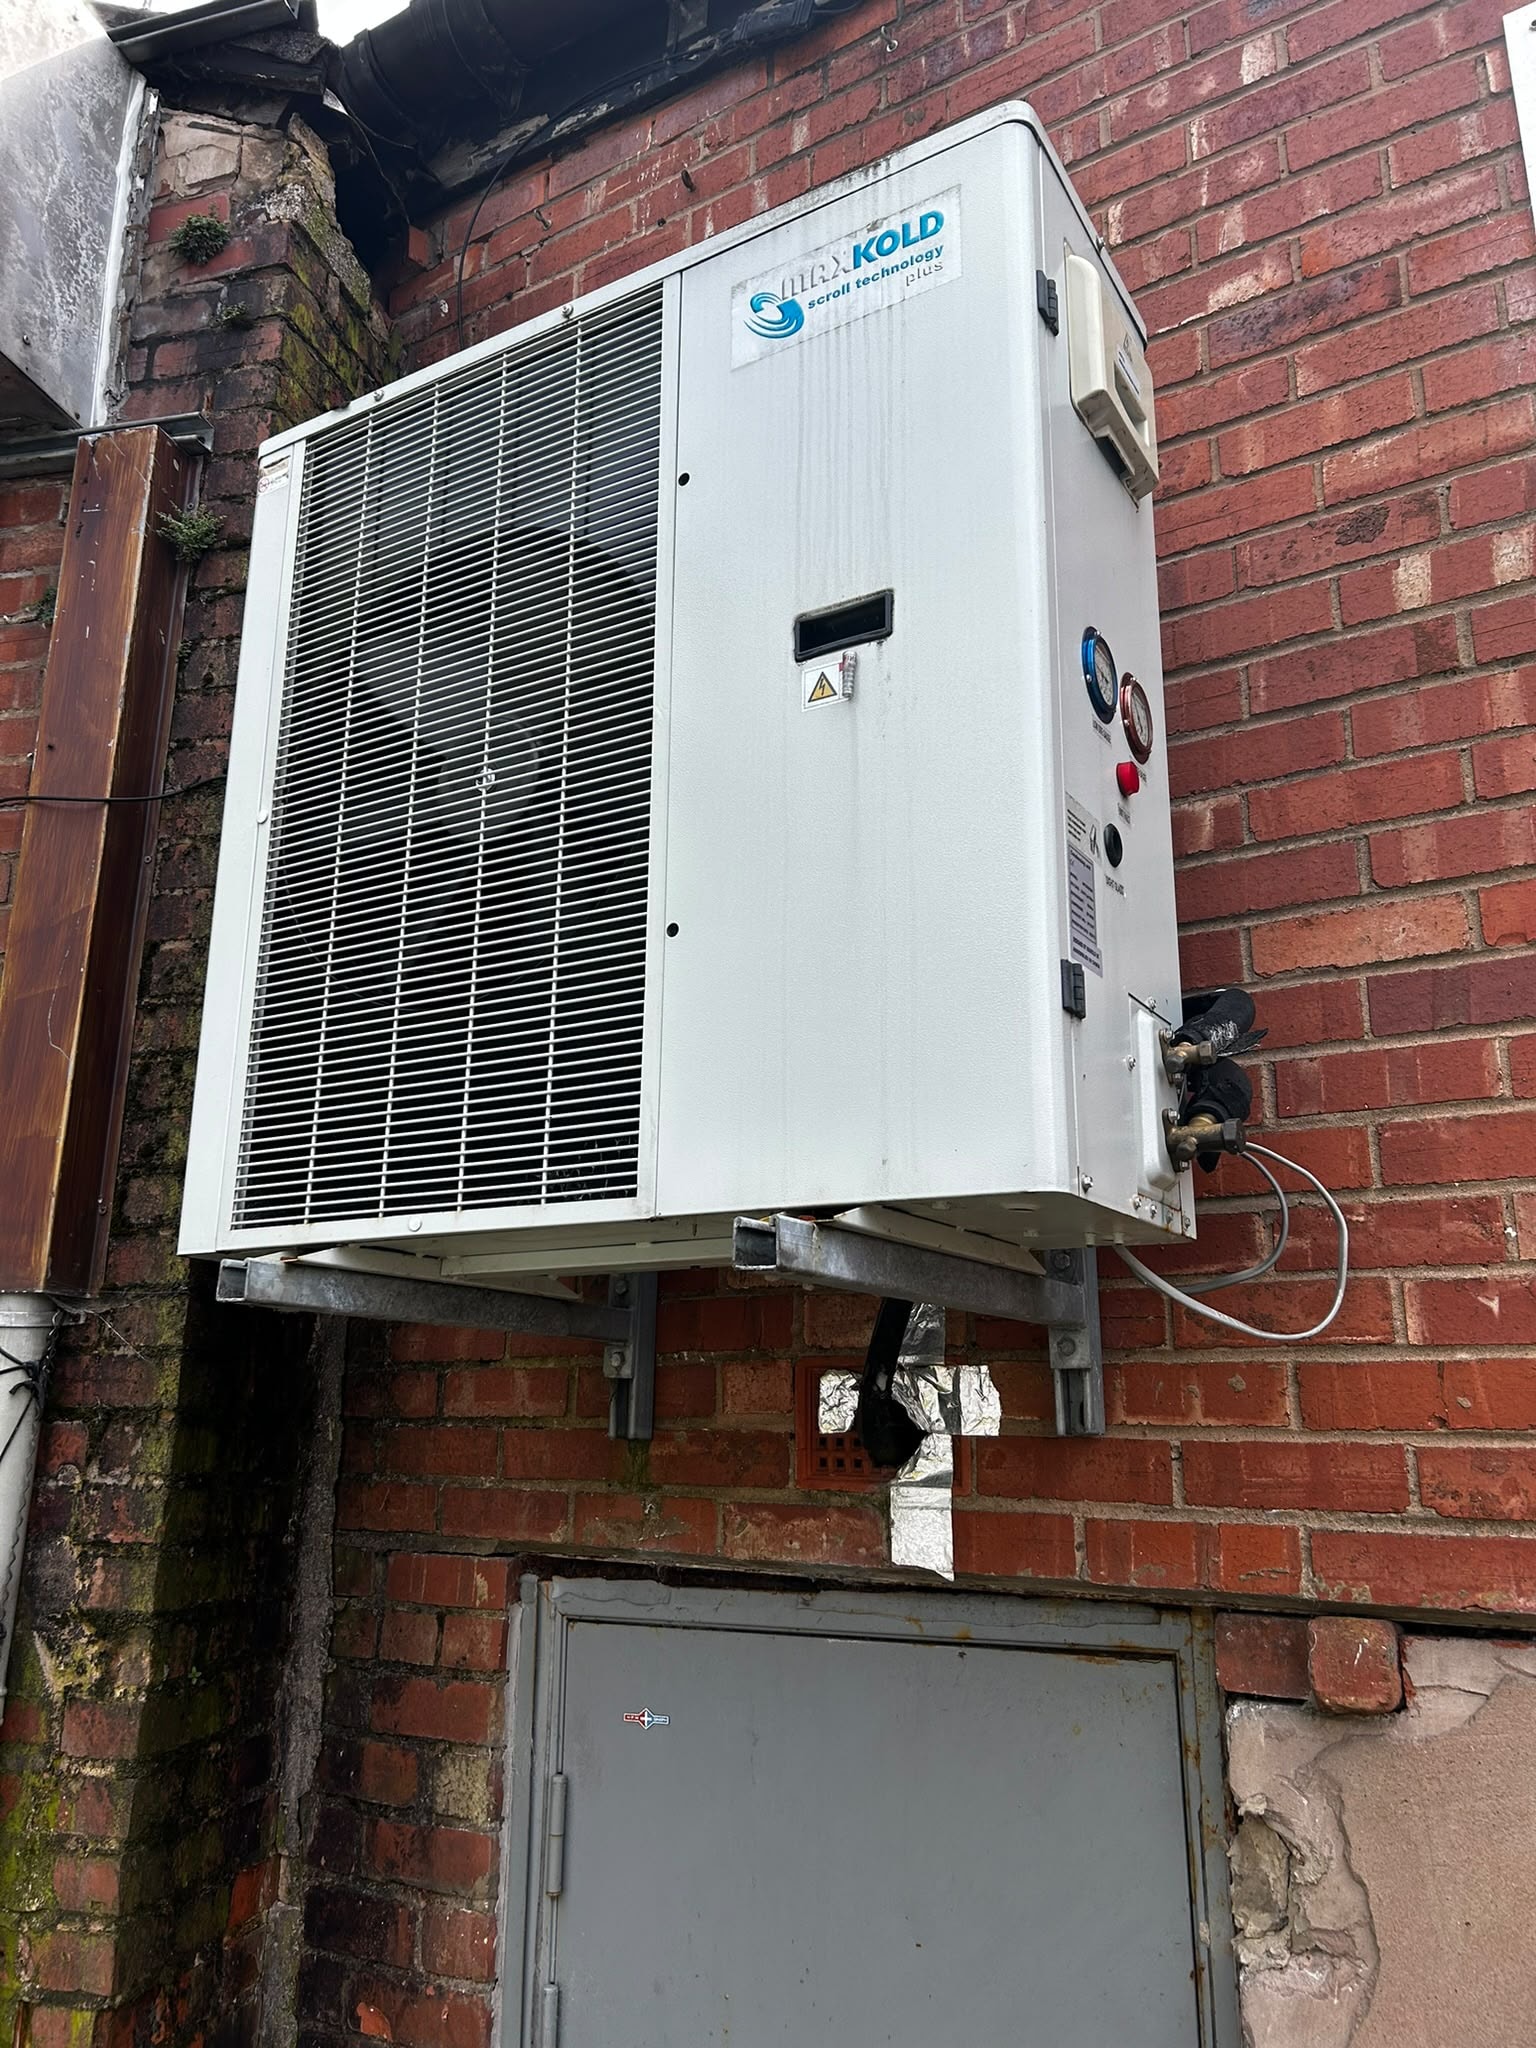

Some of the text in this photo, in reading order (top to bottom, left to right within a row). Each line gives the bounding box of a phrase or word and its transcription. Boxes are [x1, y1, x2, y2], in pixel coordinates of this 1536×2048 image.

[808, 245, 944, 309] scroll technology
[906, 261, 944, 287] plus
